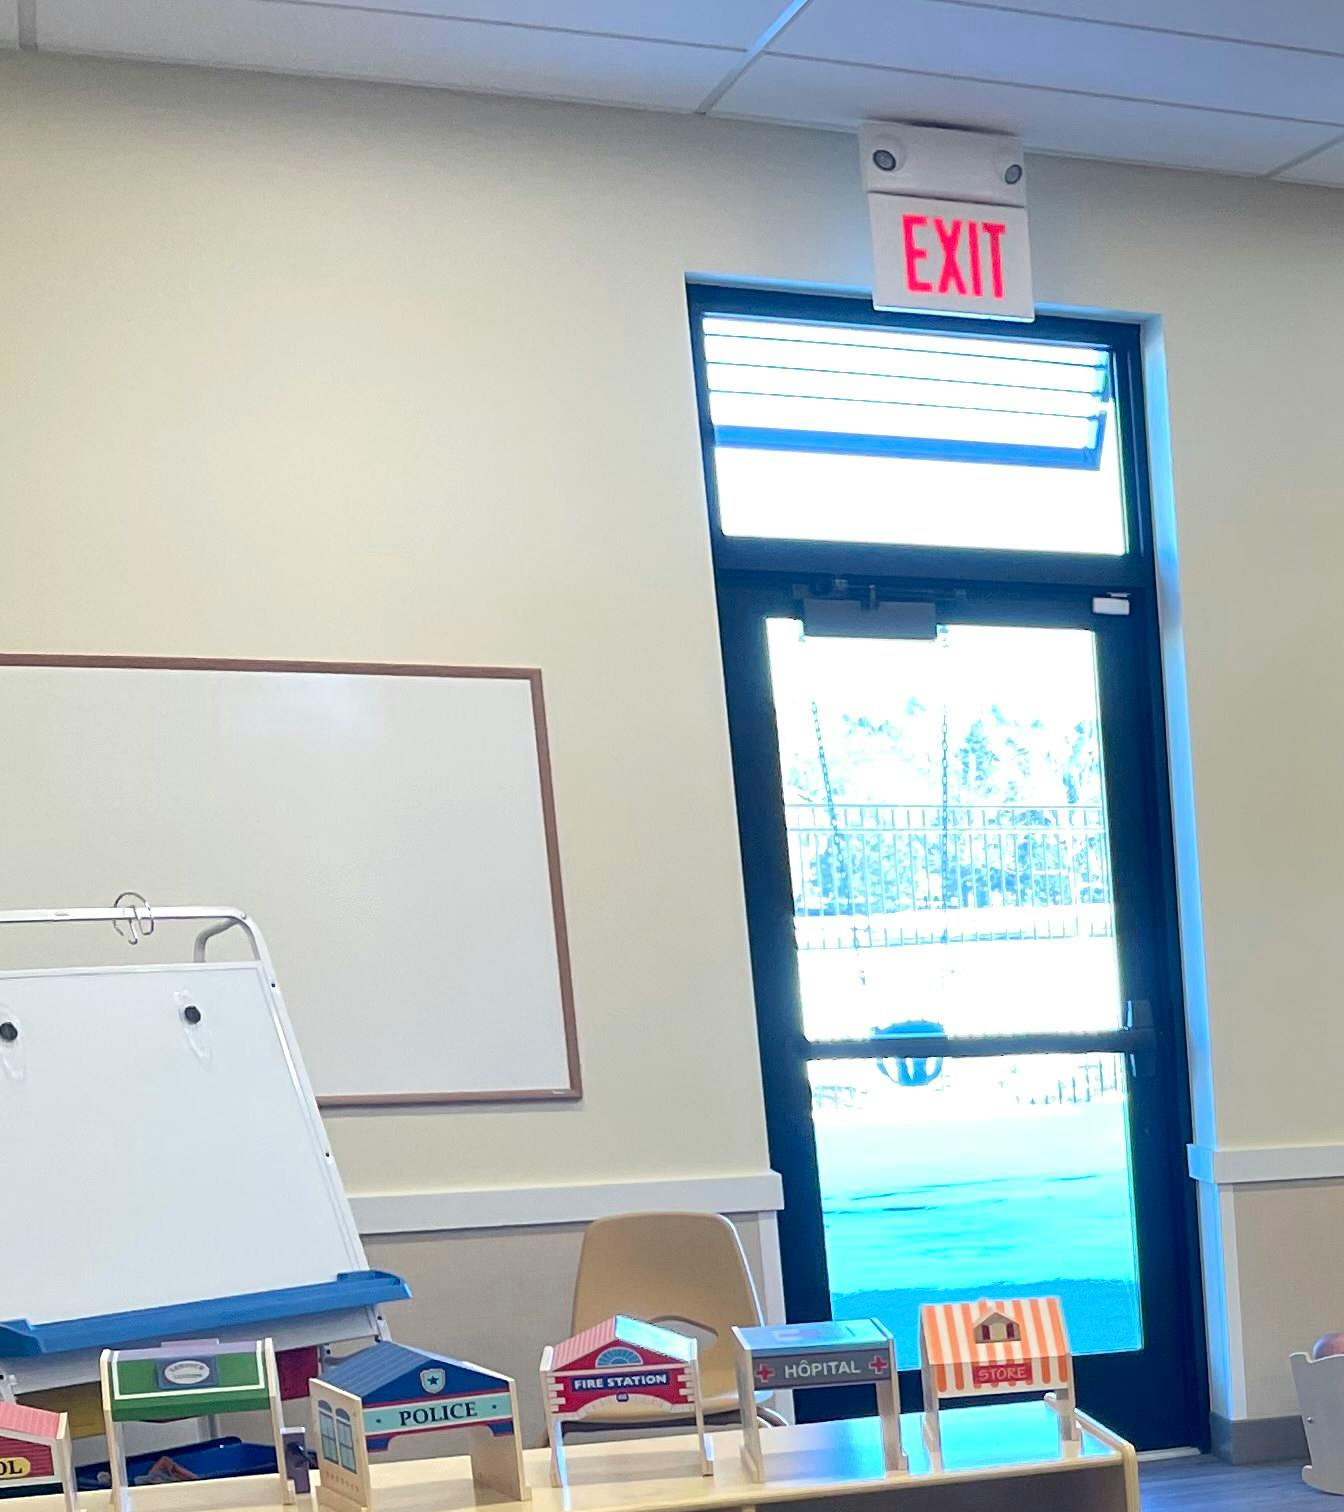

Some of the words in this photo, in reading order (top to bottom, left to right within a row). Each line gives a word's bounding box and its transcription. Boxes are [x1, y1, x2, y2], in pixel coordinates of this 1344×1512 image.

[902, 214, 1006, 299] EXIT
[784, 1359, 861, 1379] HÔPITAL
[977, 1364, 1026, 1380] STORE
[574, 1377, 604, 1390] FIRE
[607, 1373, 667, 1387] STATION
[399, 1401, 478, 1427] POLICE
